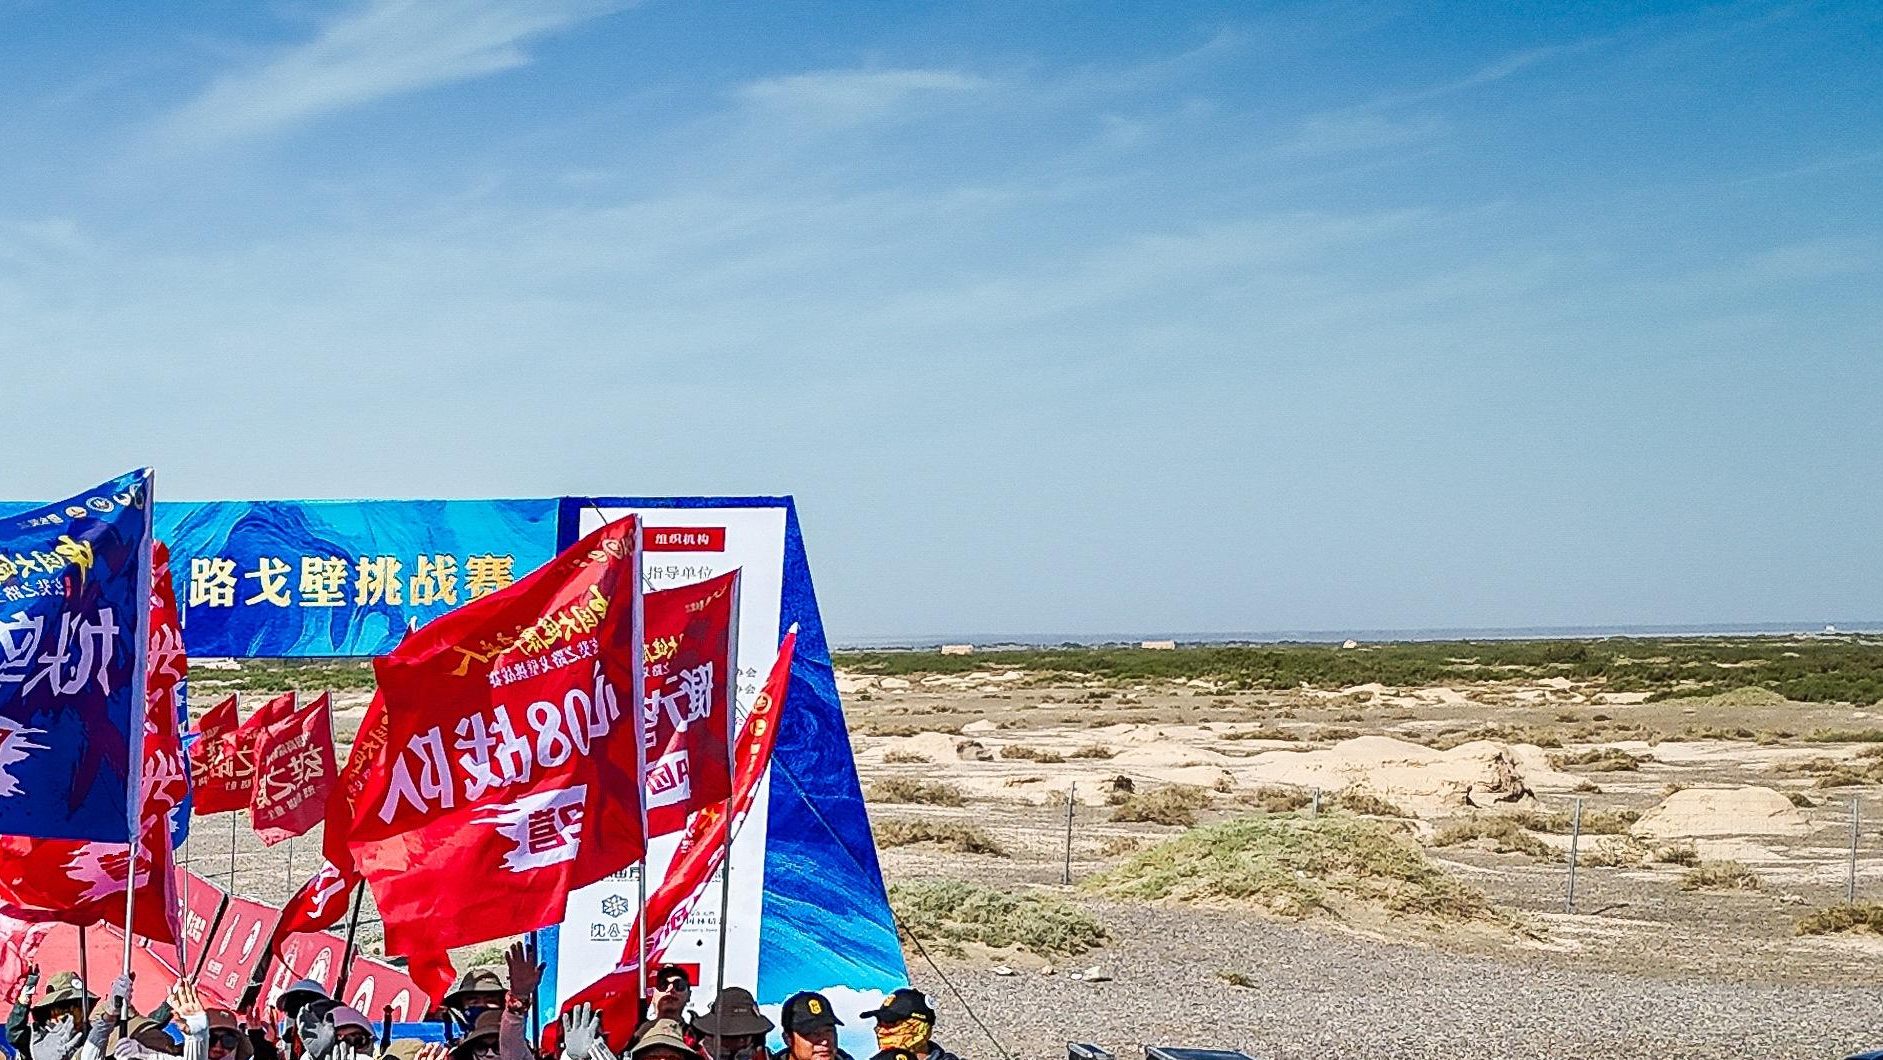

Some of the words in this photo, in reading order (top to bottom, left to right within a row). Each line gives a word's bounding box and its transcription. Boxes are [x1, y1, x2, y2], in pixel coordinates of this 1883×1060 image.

[654, 533, 710, 546] 组织机构
[647, 565, 714, 580] 指导单位
[188, 553, 515, 609] 路戈壁挑战赛
